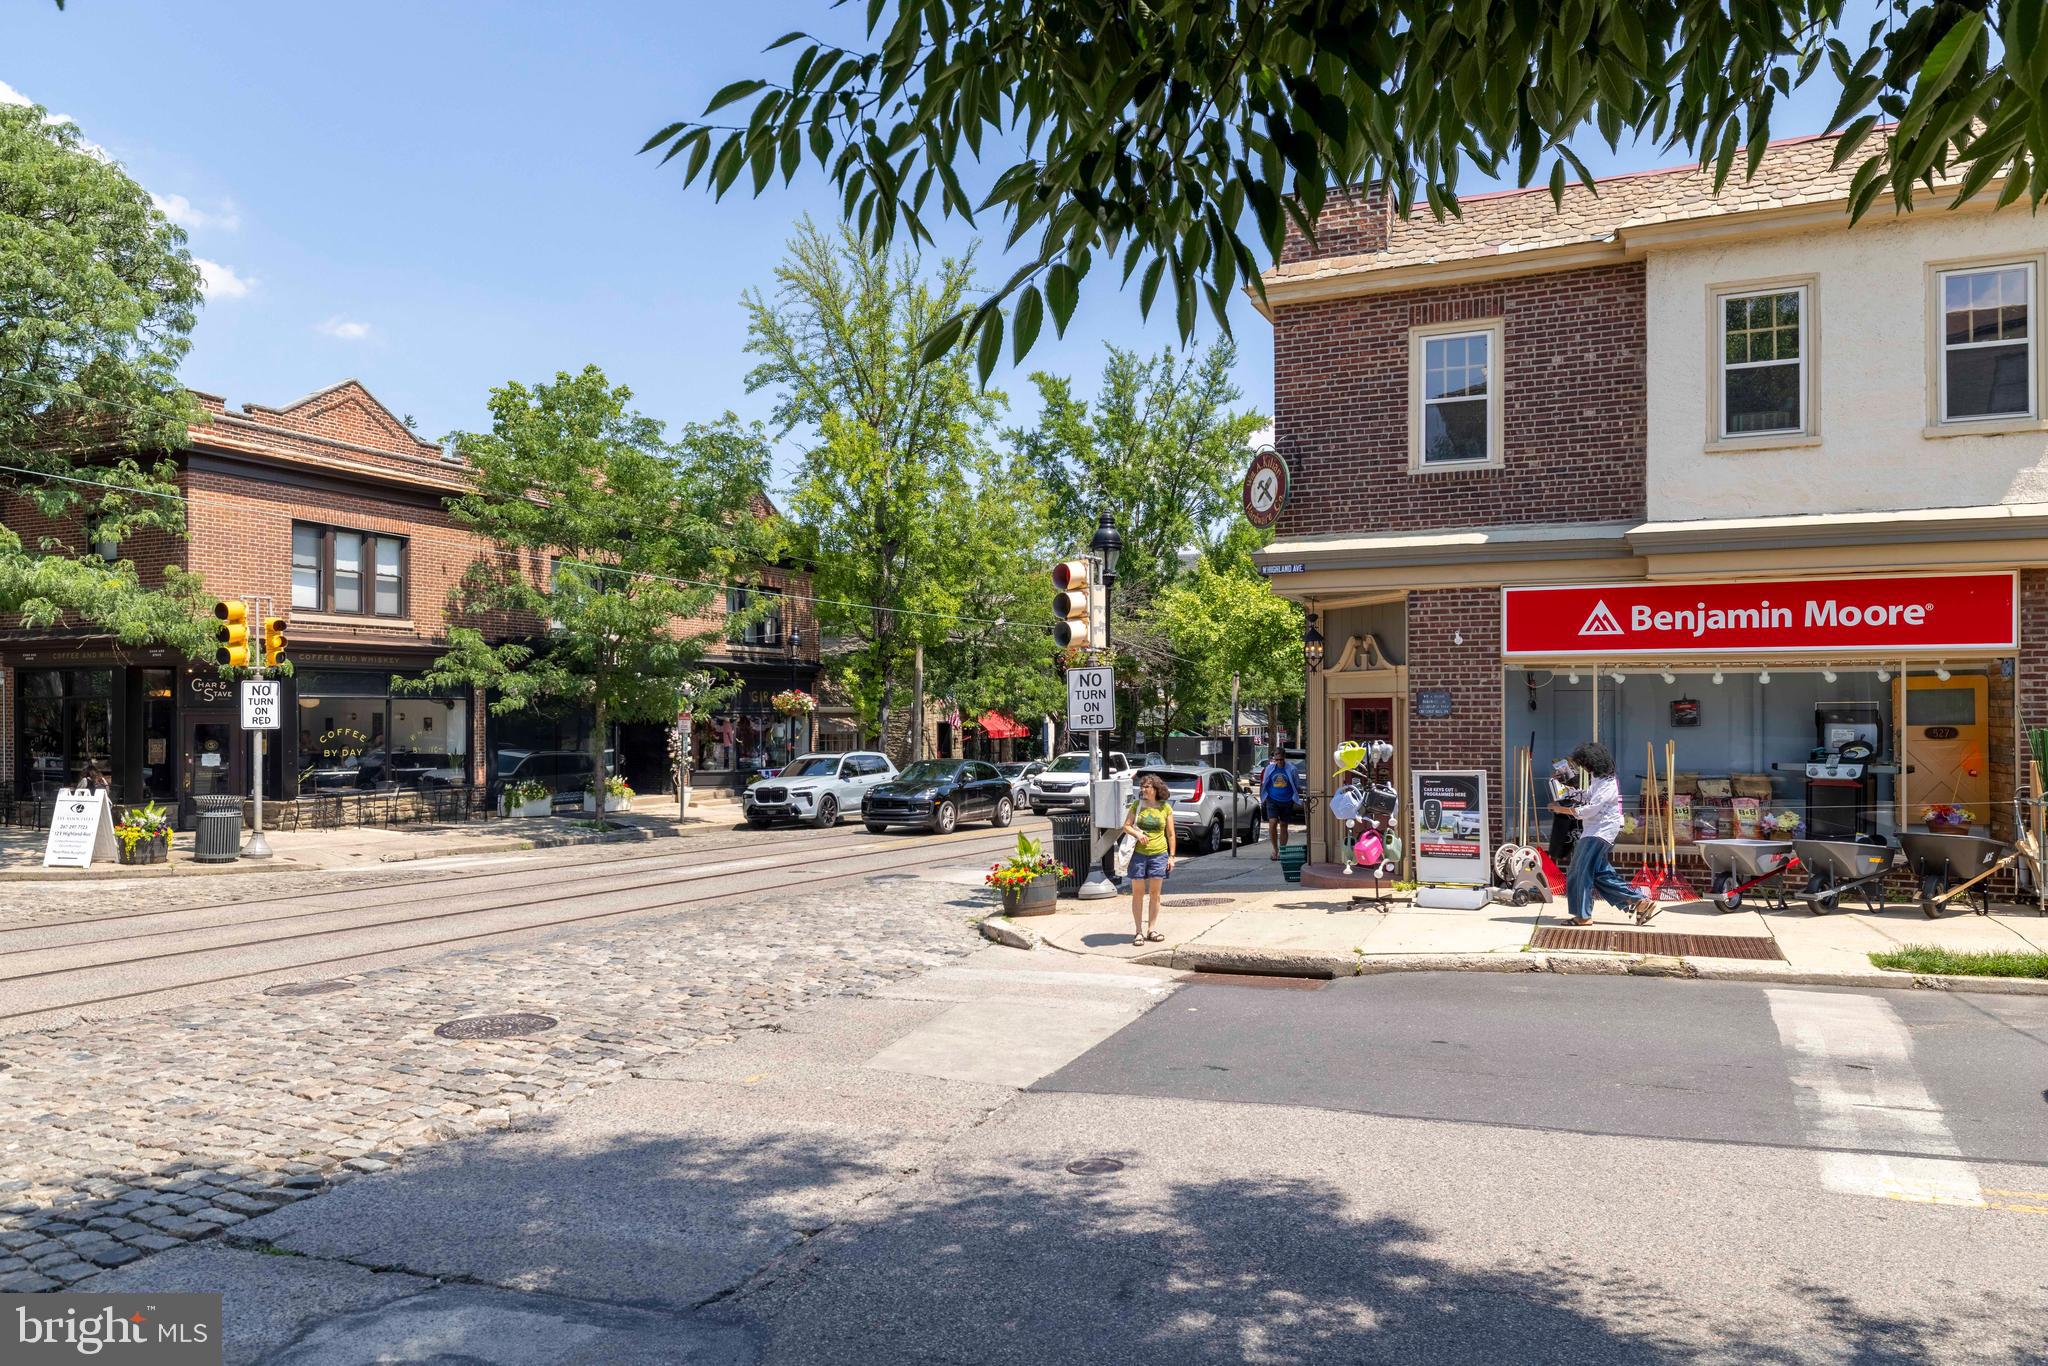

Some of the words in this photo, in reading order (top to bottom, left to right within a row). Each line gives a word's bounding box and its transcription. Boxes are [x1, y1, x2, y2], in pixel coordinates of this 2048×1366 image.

[1246, 502, 1273, 526] Hardware
[1631, 600, 1793, 637] Benjamin
[299, 653, 336, 661] COFFEE
[361, 656, 400, 664] WHISKEY
[191, 678, 217, 692] CHAR
[219, 681, 226, 690] &
[1079, 673, 1102, 688] NO
[203, 688, 232, 702] STAVE
[251, 685, 271, 696] NO
[1075, 689, 1107, 700] TURN
[248, 697, 274, 706] TURN
[1083, 702, 1100, 712] ON
[254, 707, 268, 715] ON
[252, 716, 271, 725] RED
[1080, 714, 1104, 725] RED
[319, 728, 367, 744] COFFEE
[1932, 728, 1950, 738] 527
[323, 749, 338, 758] BY
[341, 748, 363, 757] DAY
[1982, 851, 1995, 864] ACE
